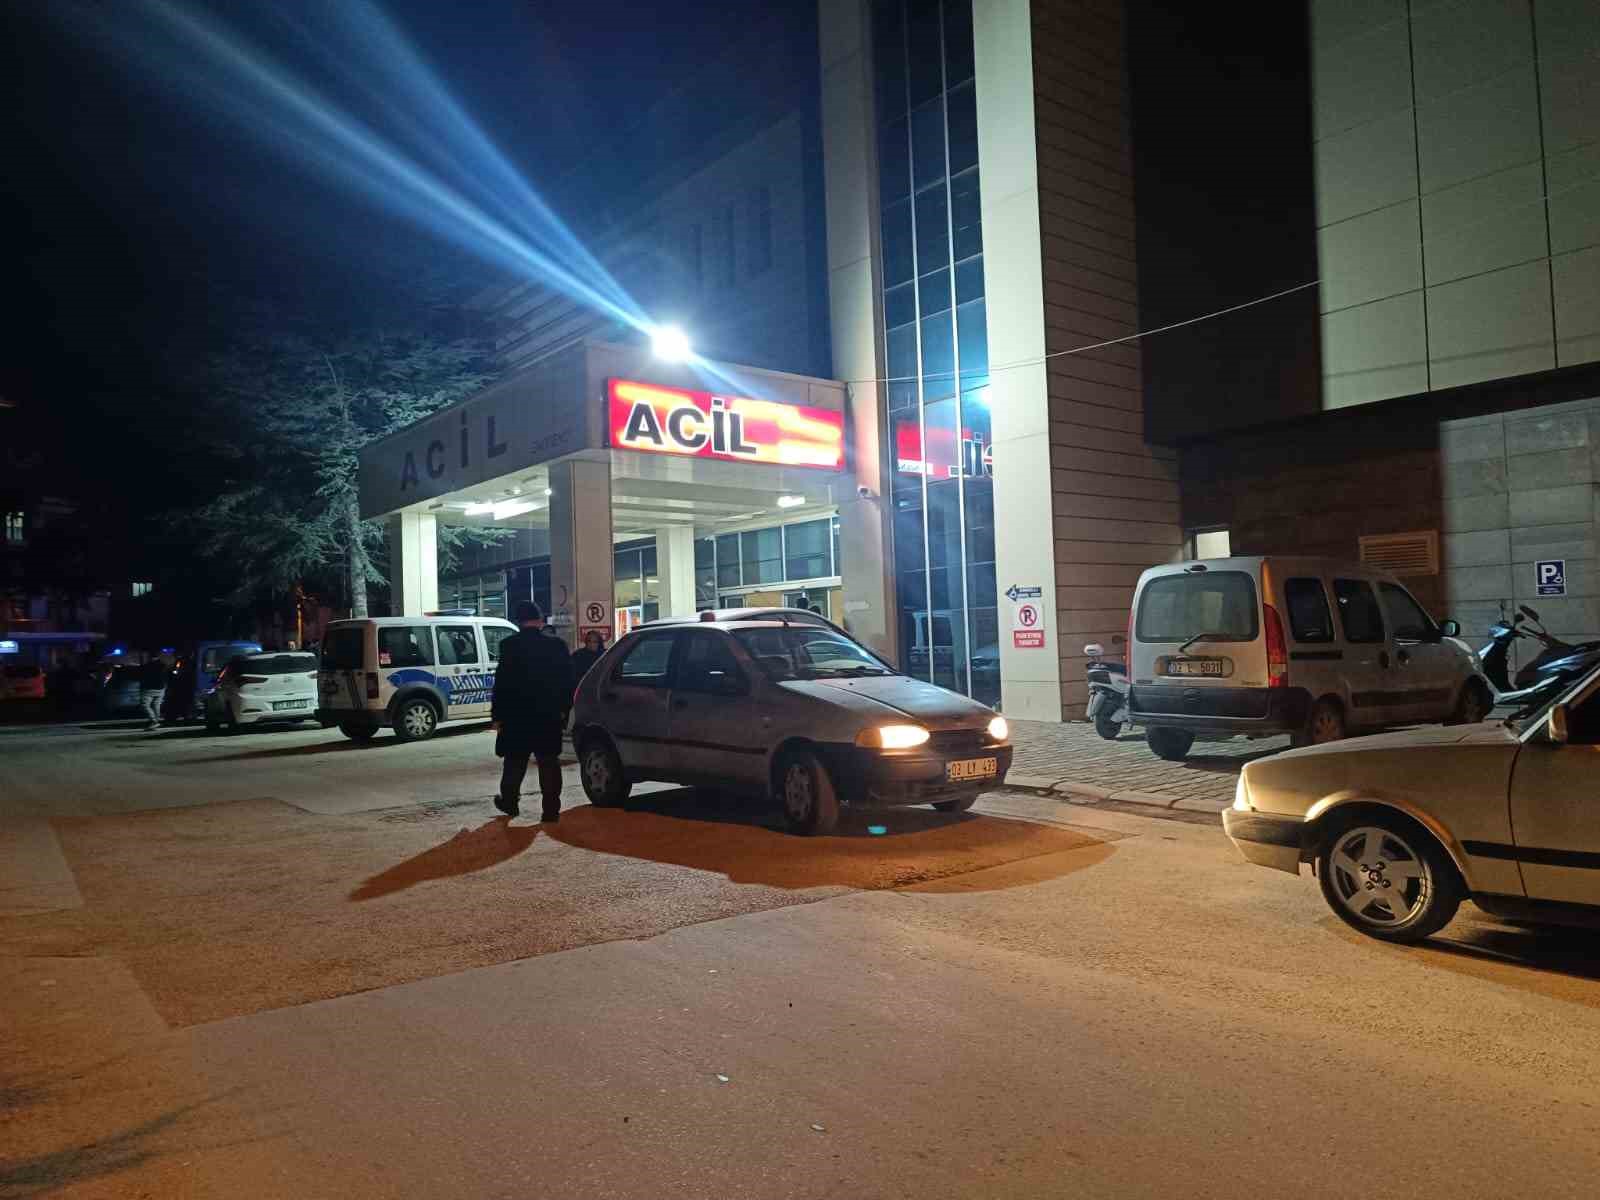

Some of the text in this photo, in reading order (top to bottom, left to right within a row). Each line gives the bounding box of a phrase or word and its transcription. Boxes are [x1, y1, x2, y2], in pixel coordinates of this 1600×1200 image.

[401, 409, 508, 491] ACİL
[622, 398, 758, 456] ACİL
[1541, 564, 1557, 584] P
